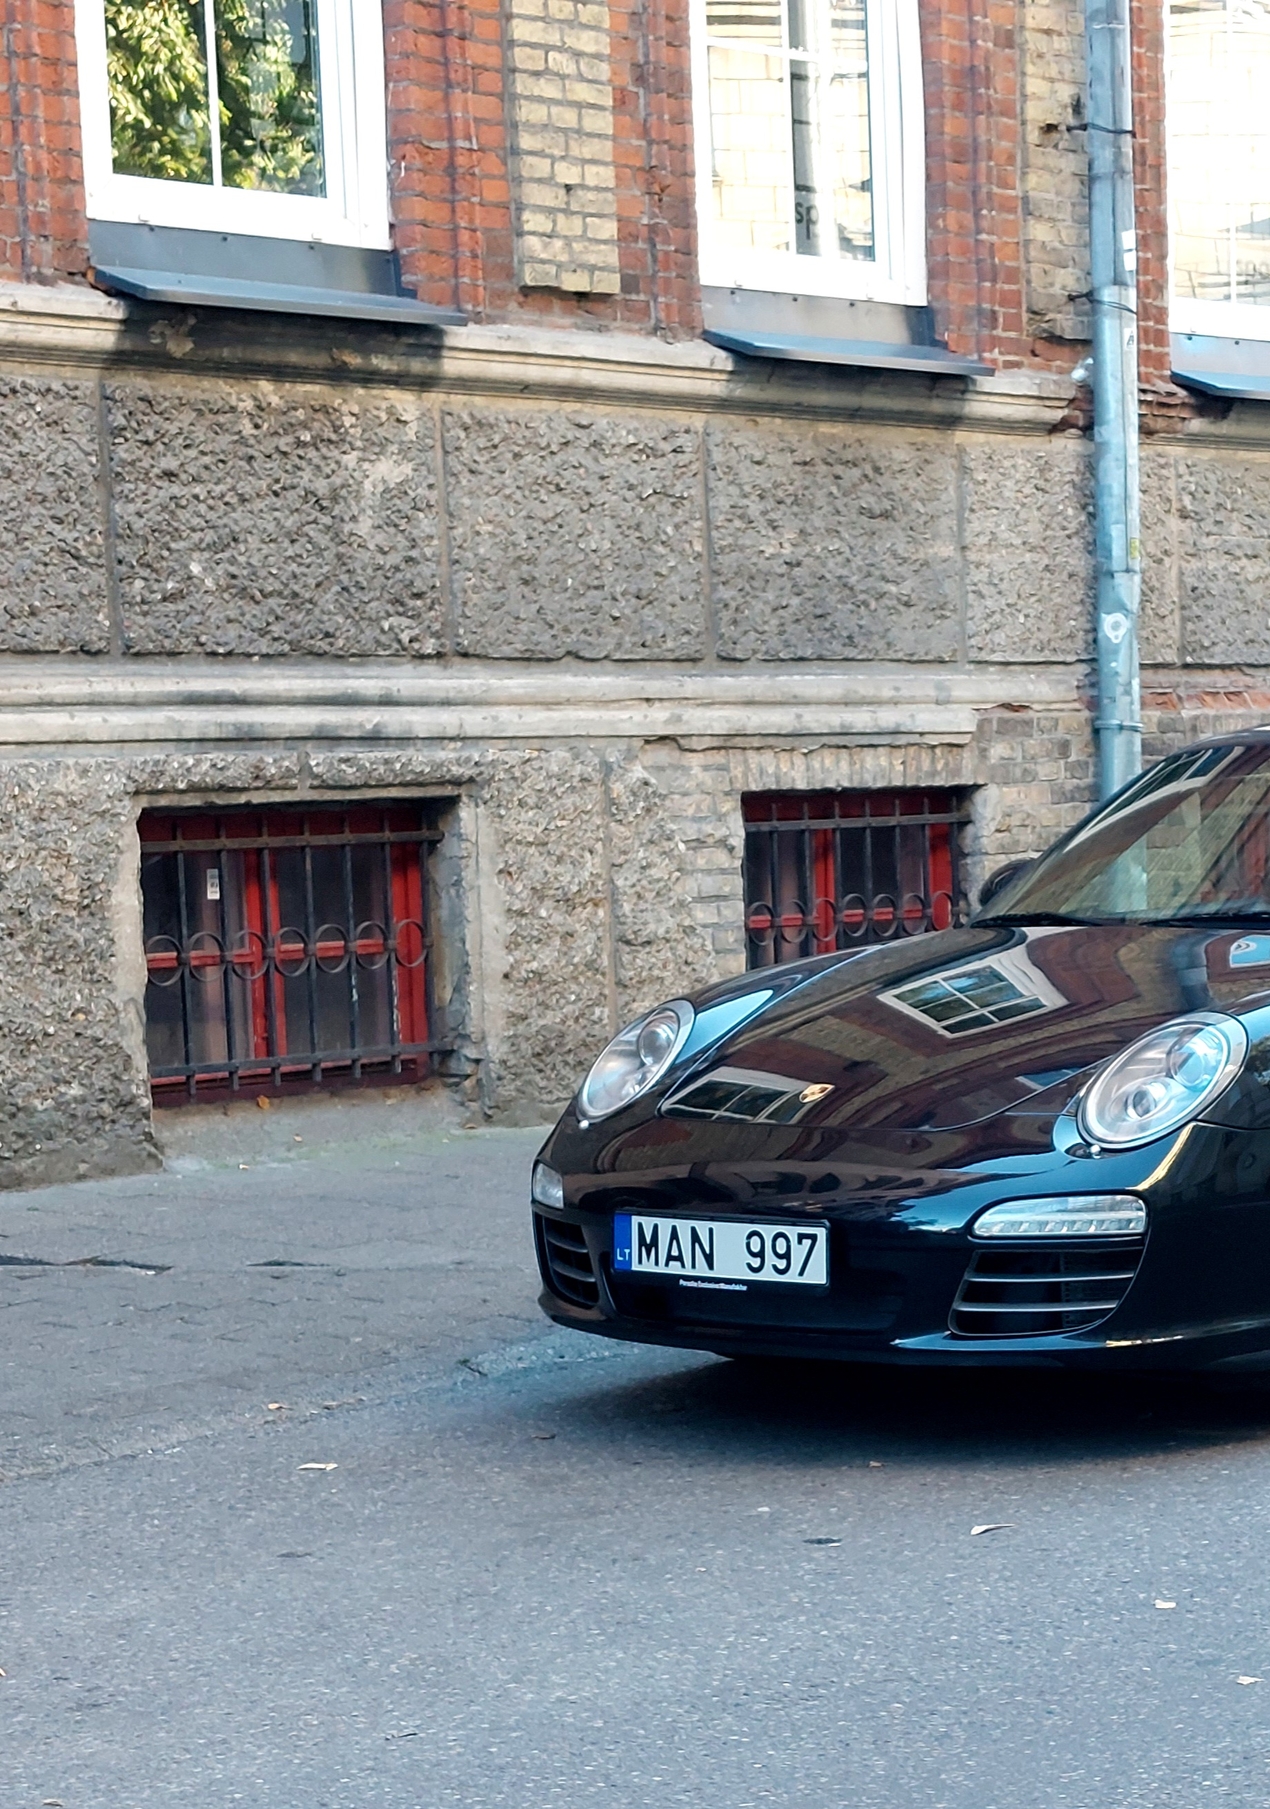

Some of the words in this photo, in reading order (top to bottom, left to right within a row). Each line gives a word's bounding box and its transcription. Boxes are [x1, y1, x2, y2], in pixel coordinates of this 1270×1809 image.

[616, 1247, 631, 1261] LT
[637, 1221, 715, 1271] MAN
[745, 1229, 819, 1277] 997
